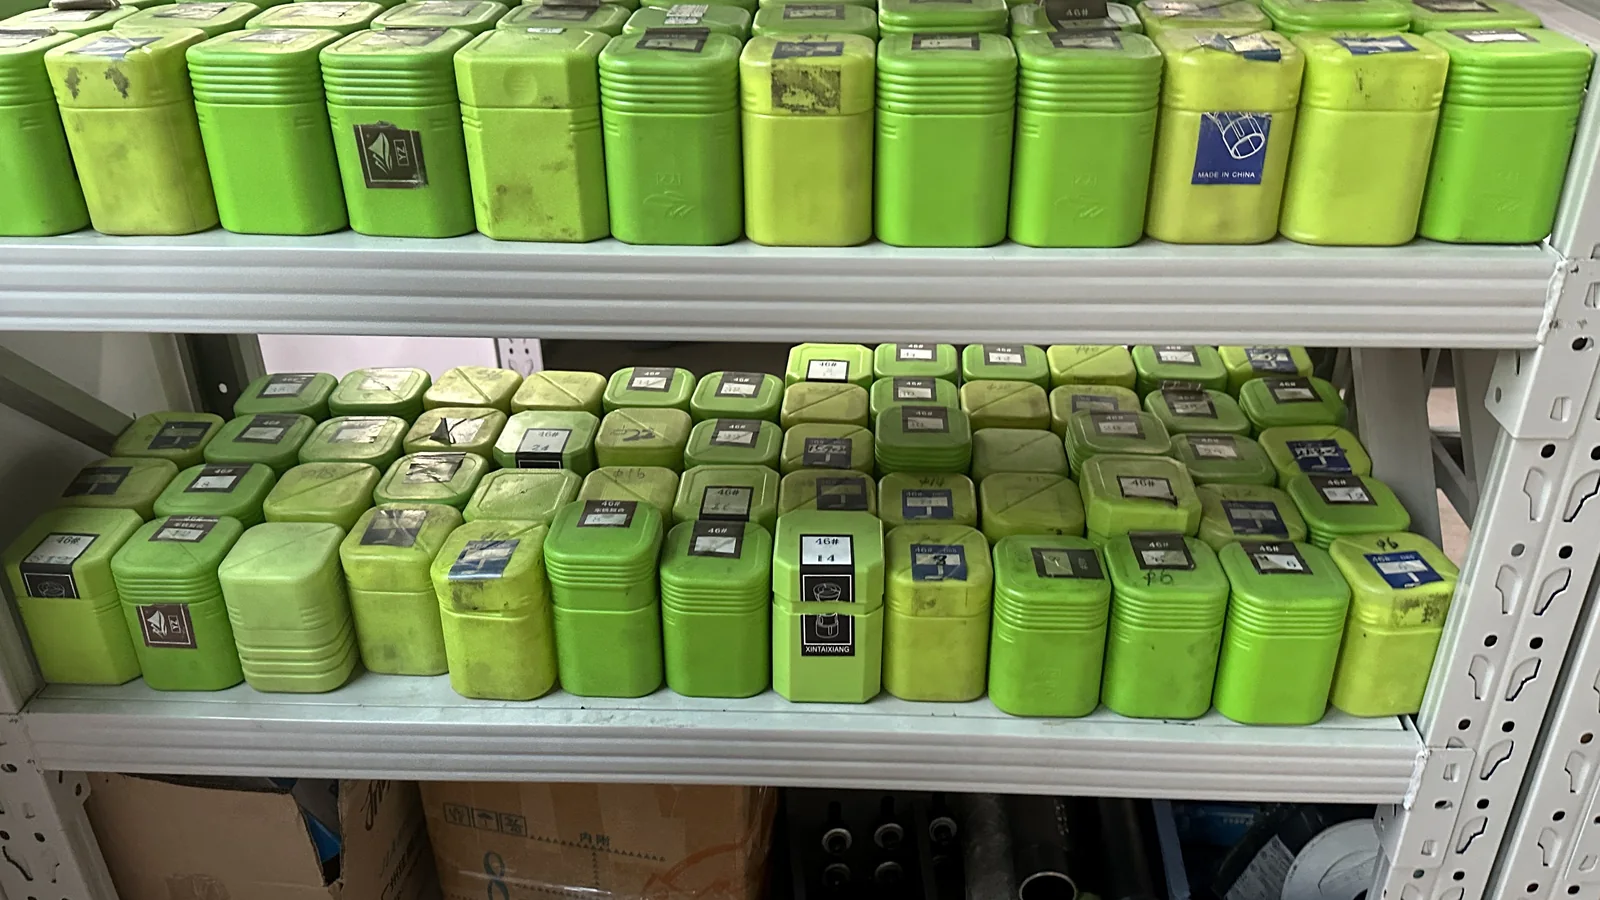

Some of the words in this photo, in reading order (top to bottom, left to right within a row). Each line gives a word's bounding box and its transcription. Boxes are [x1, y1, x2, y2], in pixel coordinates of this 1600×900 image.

[397, 147, 407, 161] YZ
[1231, 171, 1256, 179] CHINA
[56, 535, 82, 545] 46#
[815, 537, 839, 546] 46#
[805, 645, 850, 654] XINTAIXIANG
